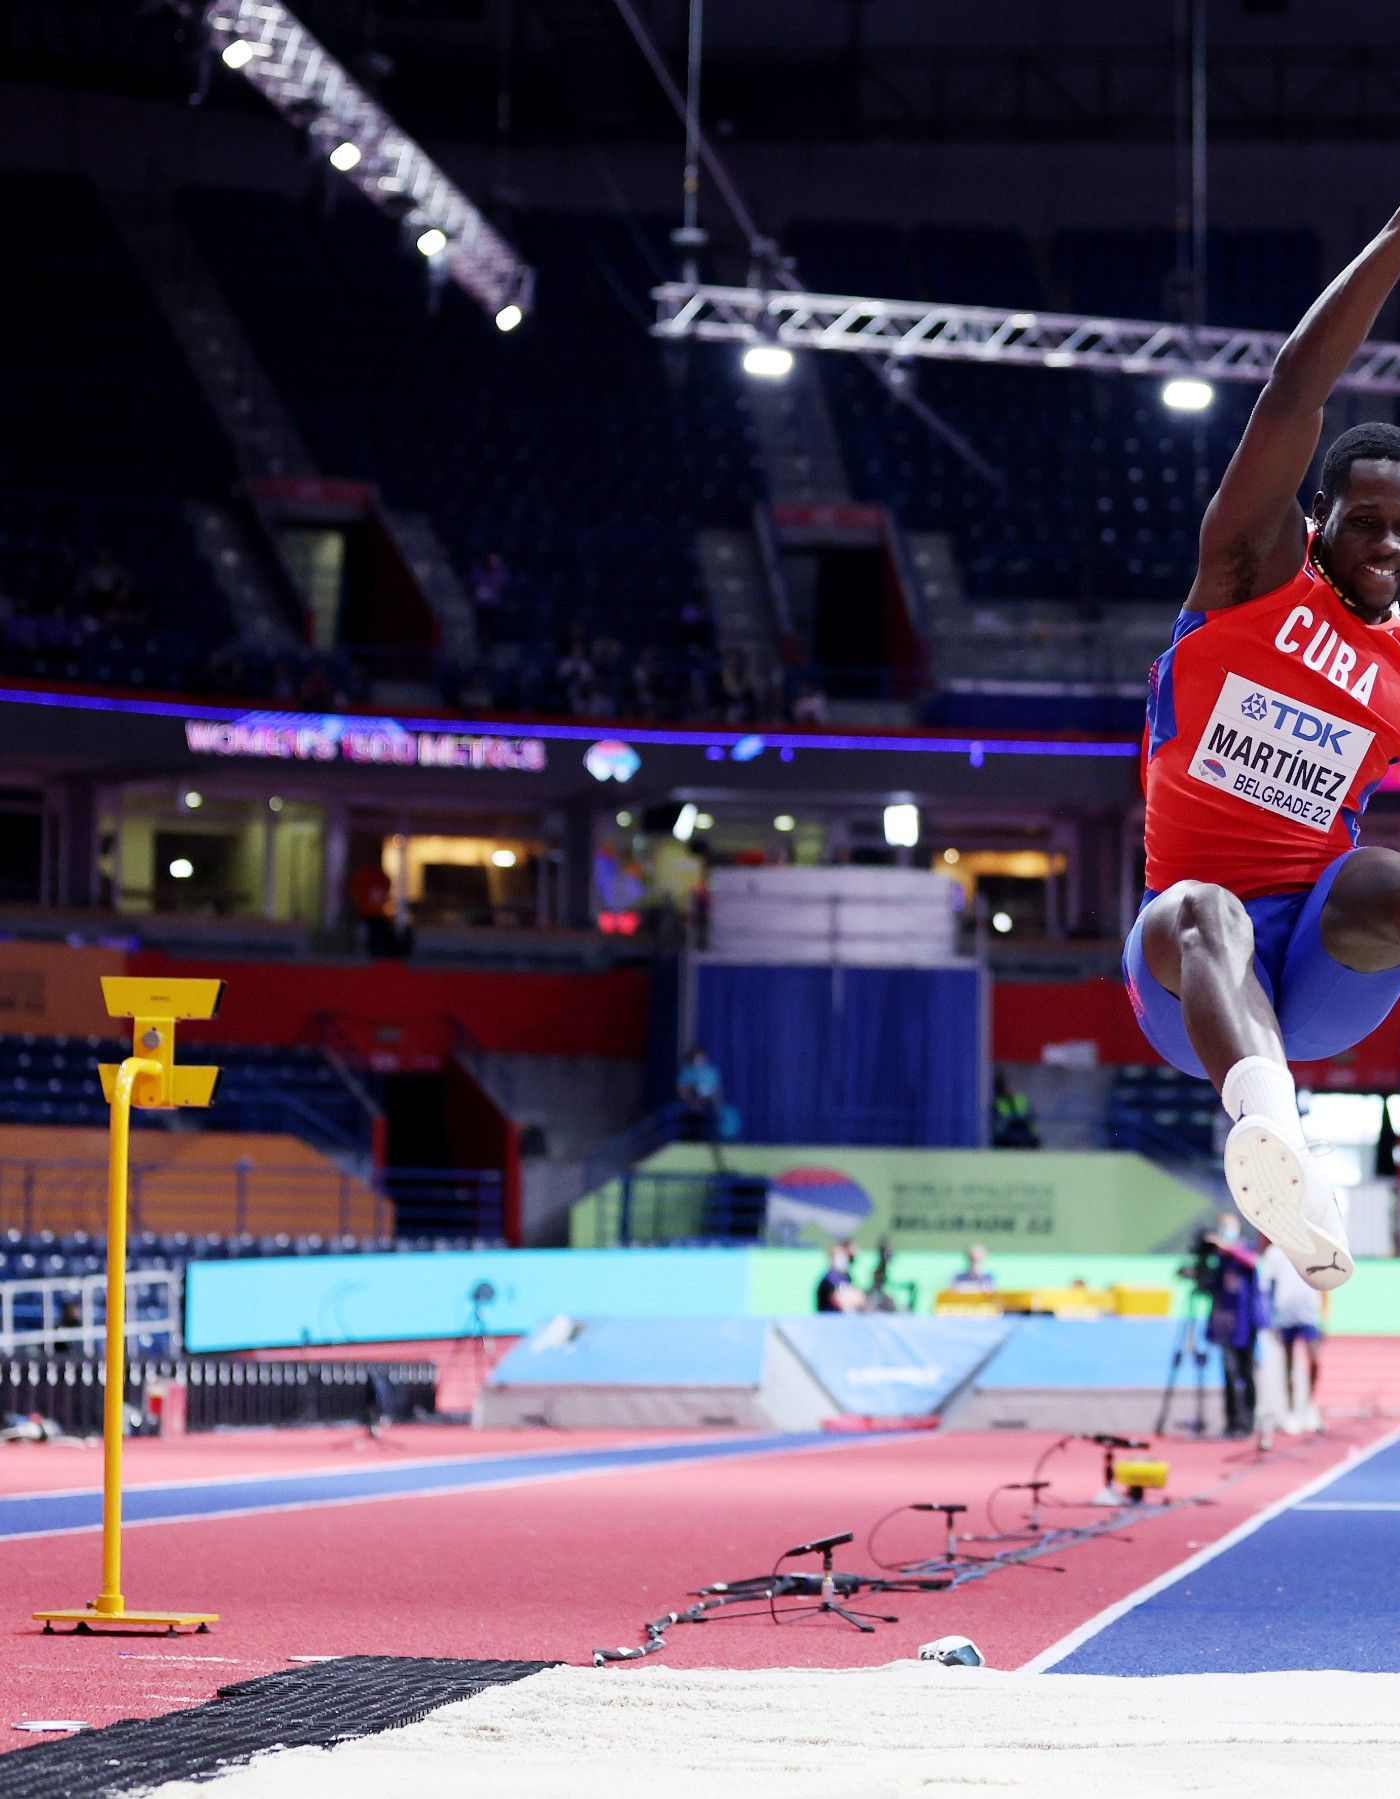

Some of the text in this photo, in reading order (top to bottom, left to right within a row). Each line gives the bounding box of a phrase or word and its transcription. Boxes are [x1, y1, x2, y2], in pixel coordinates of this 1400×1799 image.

[1274, 606, 1379, 707] CUBA
[1271, 700, 1352, 755] TDK
[1207, 723, 1347, 802] MARTÍNEZ
[1233, 773, 1331, 825] BELGRADE 22
